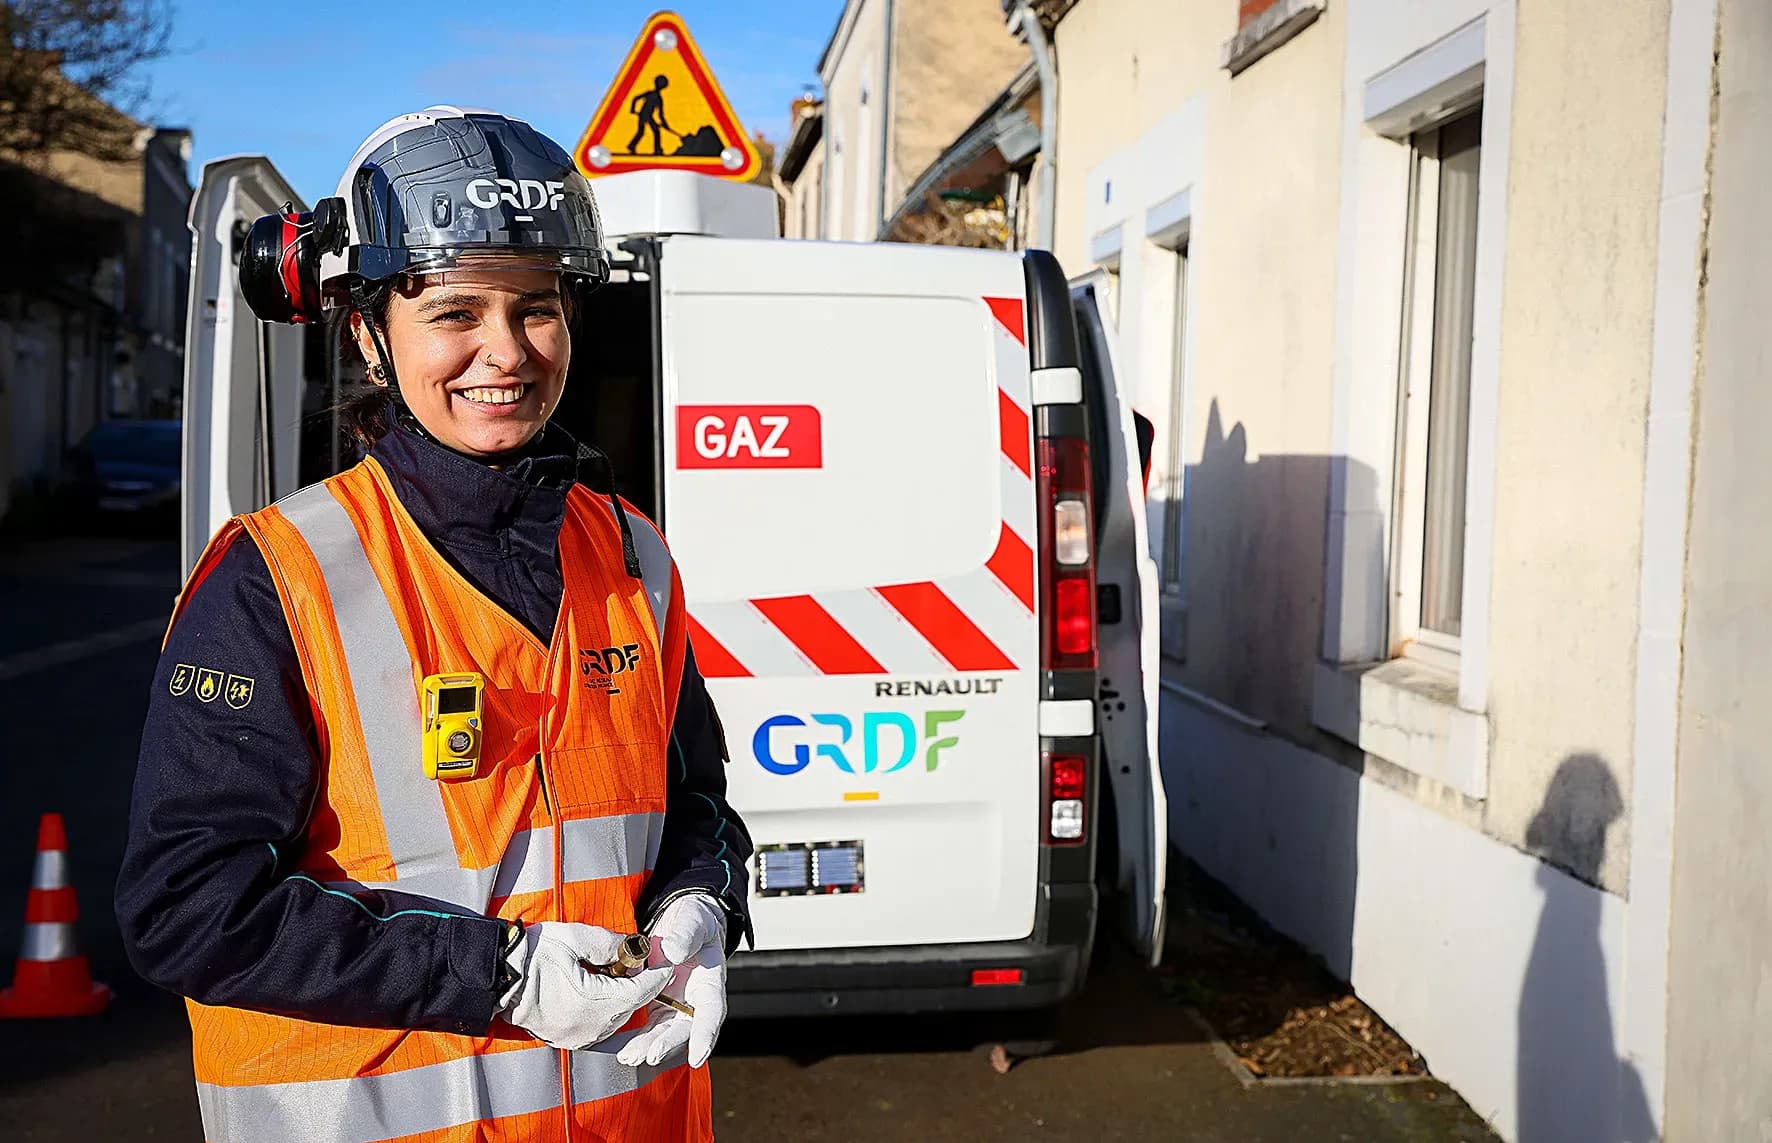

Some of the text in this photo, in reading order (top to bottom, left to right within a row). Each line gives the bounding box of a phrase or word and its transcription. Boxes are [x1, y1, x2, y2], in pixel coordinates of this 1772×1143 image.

[465, 178, 565, 211] GRDF
[694, 415, 790, 459] GAZ
[875, 678, 1003, 697] RENAULT
[752, 710, 966, 776] GRDF
